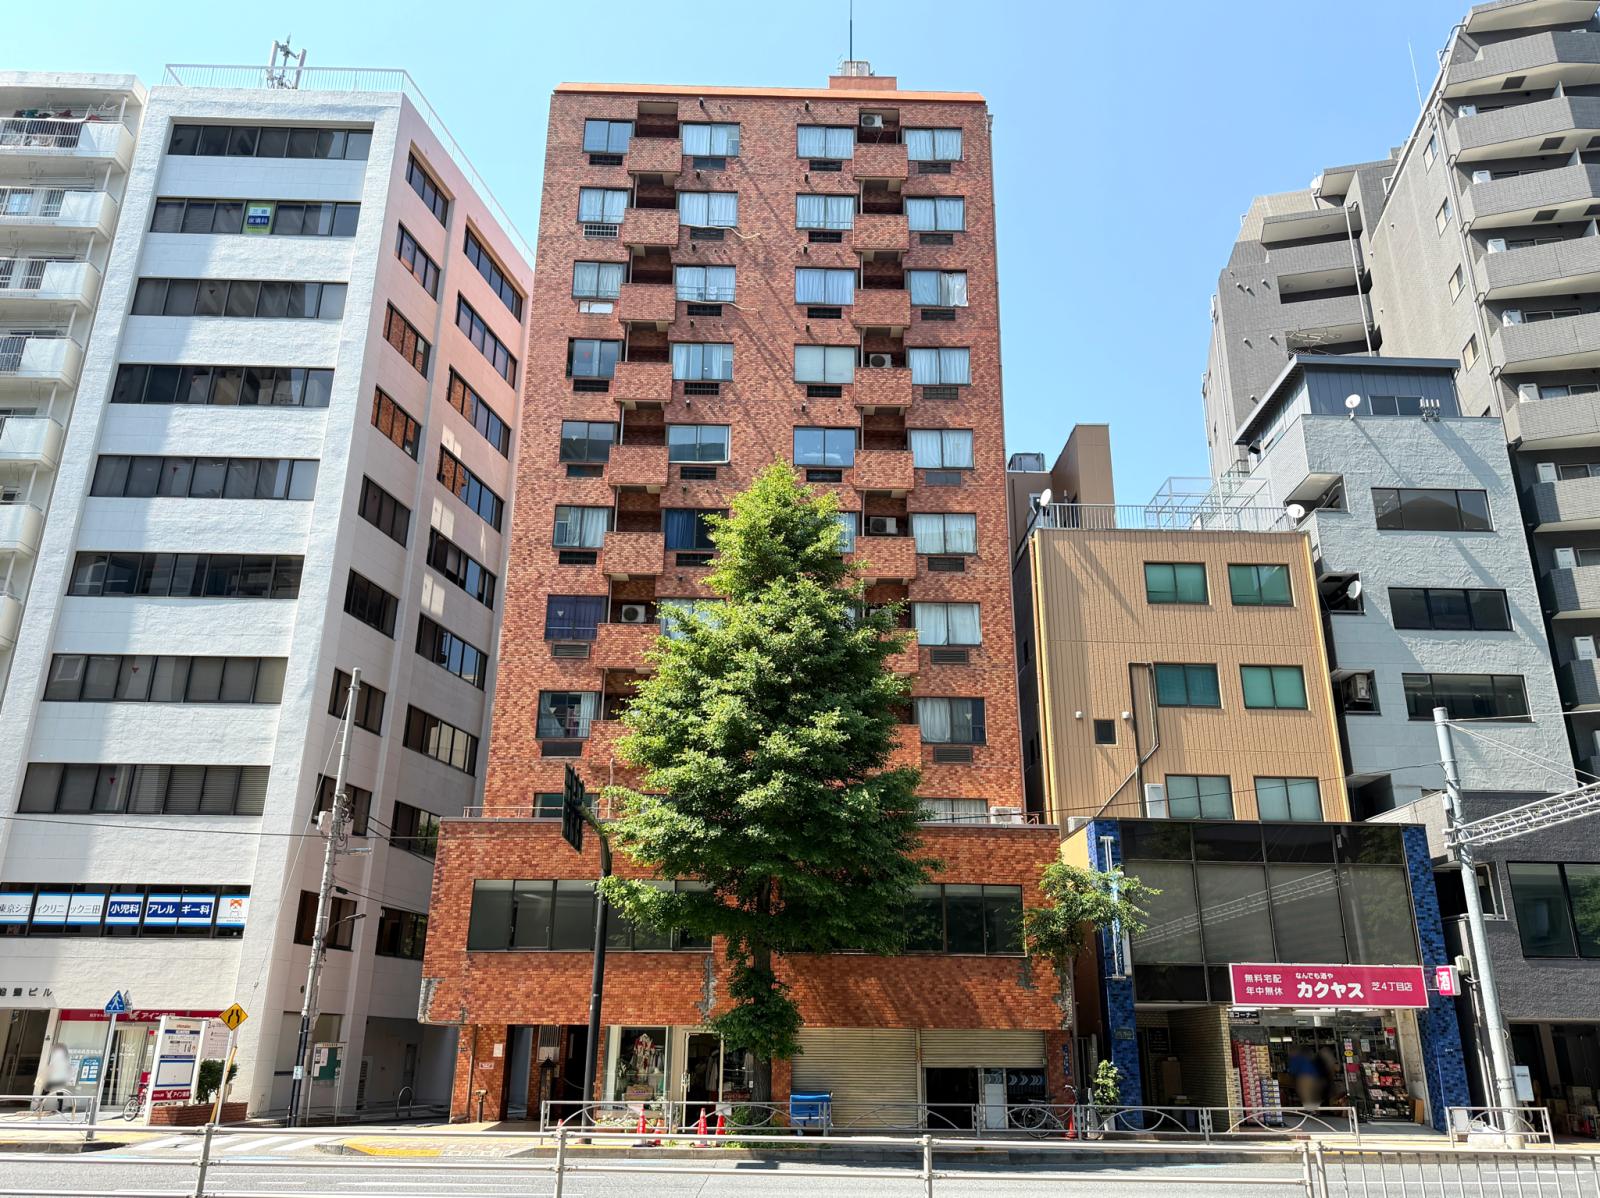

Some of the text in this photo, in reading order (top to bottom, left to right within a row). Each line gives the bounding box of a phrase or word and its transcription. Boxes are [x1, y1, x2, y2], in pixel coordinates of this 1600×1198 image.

[110, 903, 140, 914] 小児科
[148, 904, 210, 915] アレルギー科
[1244, 974, 1282, 984] 無料宅配
[1295, 972, 1334, 980] なんでも酒や
[1438, 971, 1451, 991] 酒
[1246, 986, 1284, 996] 年中無休
[1296, 981, 1365, 999] カクヤス
[1371, 982, 1413, 992] 芝4丁目店
